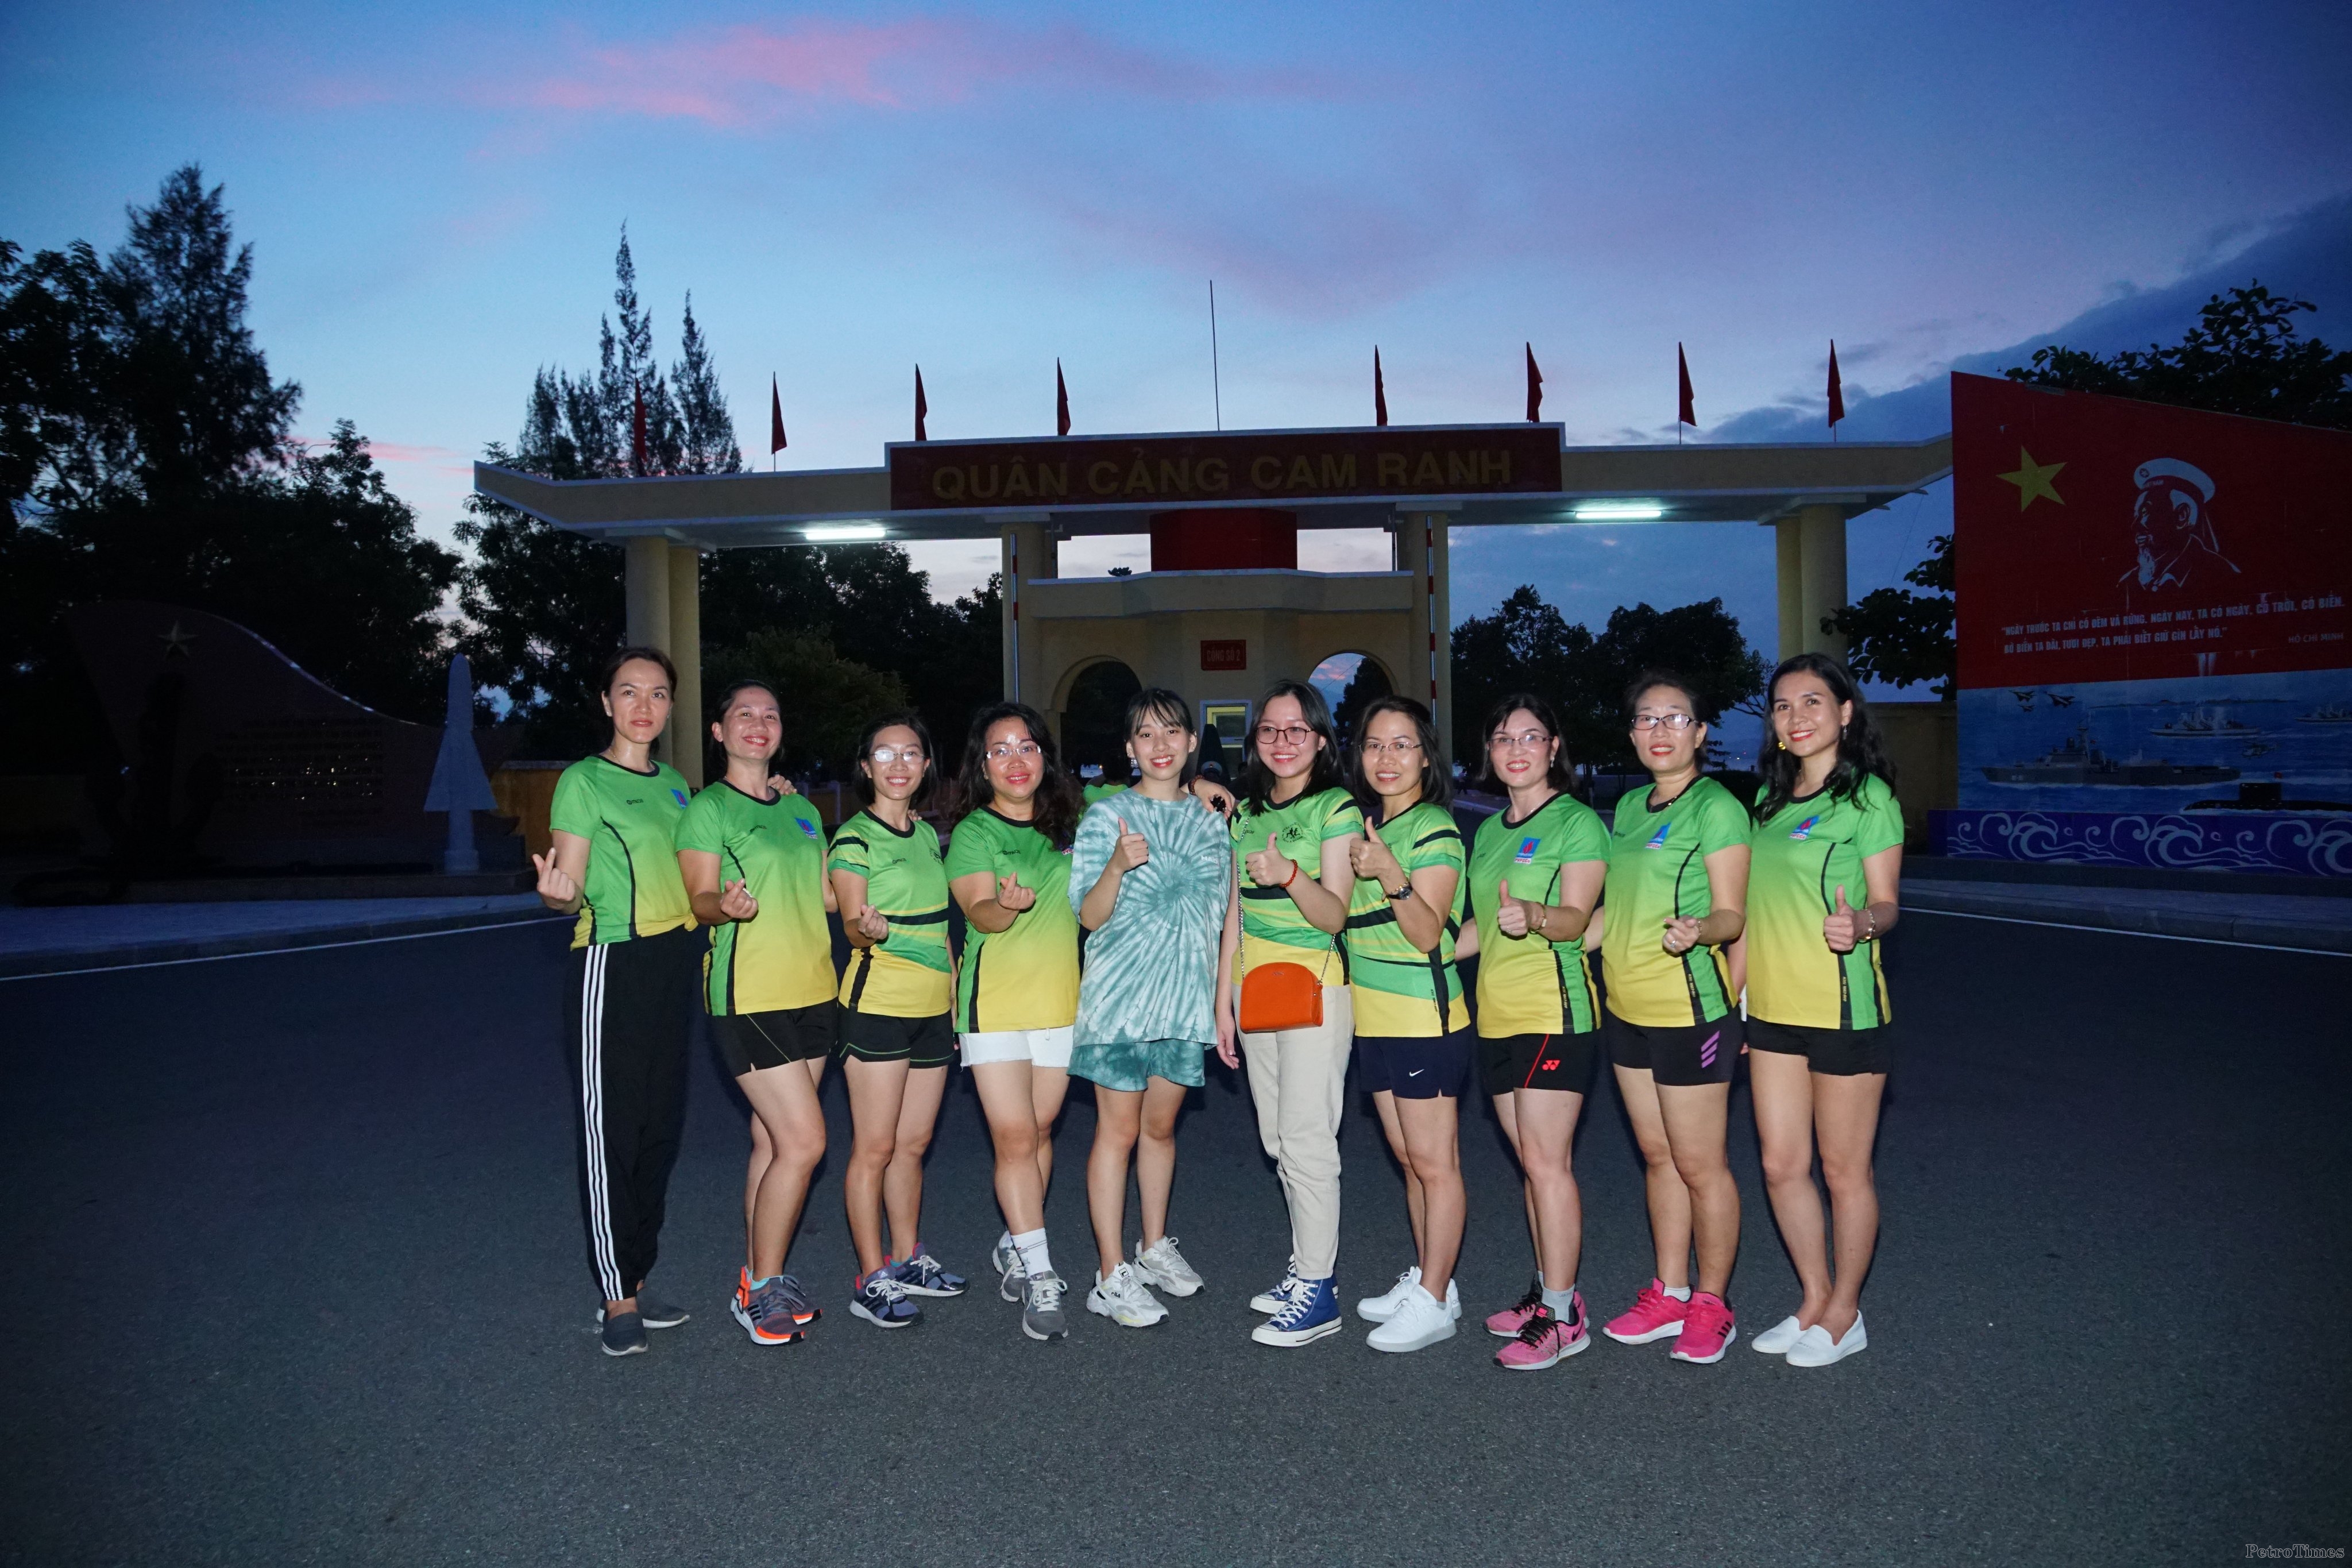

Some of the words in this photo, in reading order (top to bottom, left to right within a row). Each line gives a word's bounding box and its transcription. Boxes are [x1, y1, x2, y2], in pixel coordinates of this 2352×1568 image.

[932, 455, 1068, 500] QUÂN
[1088, 446, 1229, 495] CẢNG
[1250, 453, 1357, 491] CAM
[1378, 450, 1511, 488] RANH
[2052, 621, 2061, 631] TA
[2063, 616, 2076, 631] CHỈ
[2079, 617, 2089, 629] CÓ
[2091, 616, 2108, 628] ĐÊM
[2110, 615, 2121, 627] VÀ
[2150, 610, 2172, 623] NGÀY
[2197, 609, 2208, 619] TA
[2211, 605, 2222, 618] CÓ
[2301, 596, 2315, 610] CÓ
[1236, 649, 1241, 662] 2
[2005, 642, 2014, 654] BỜ
[2017, 638, 2033, 653] BIỂN
[2036, 642, 2044, 652] TA
[2063, 638, 2079, 649] TƯƠI
[2102, 637, 2110, 646] TA
[2113, 631, 2131, 645] PHẢI
[2134, 629, 2152, 643] BIẾT
[2155, 630, 2169, 642] GIỮ
[2171, 628, 2186, 642] GÌN
